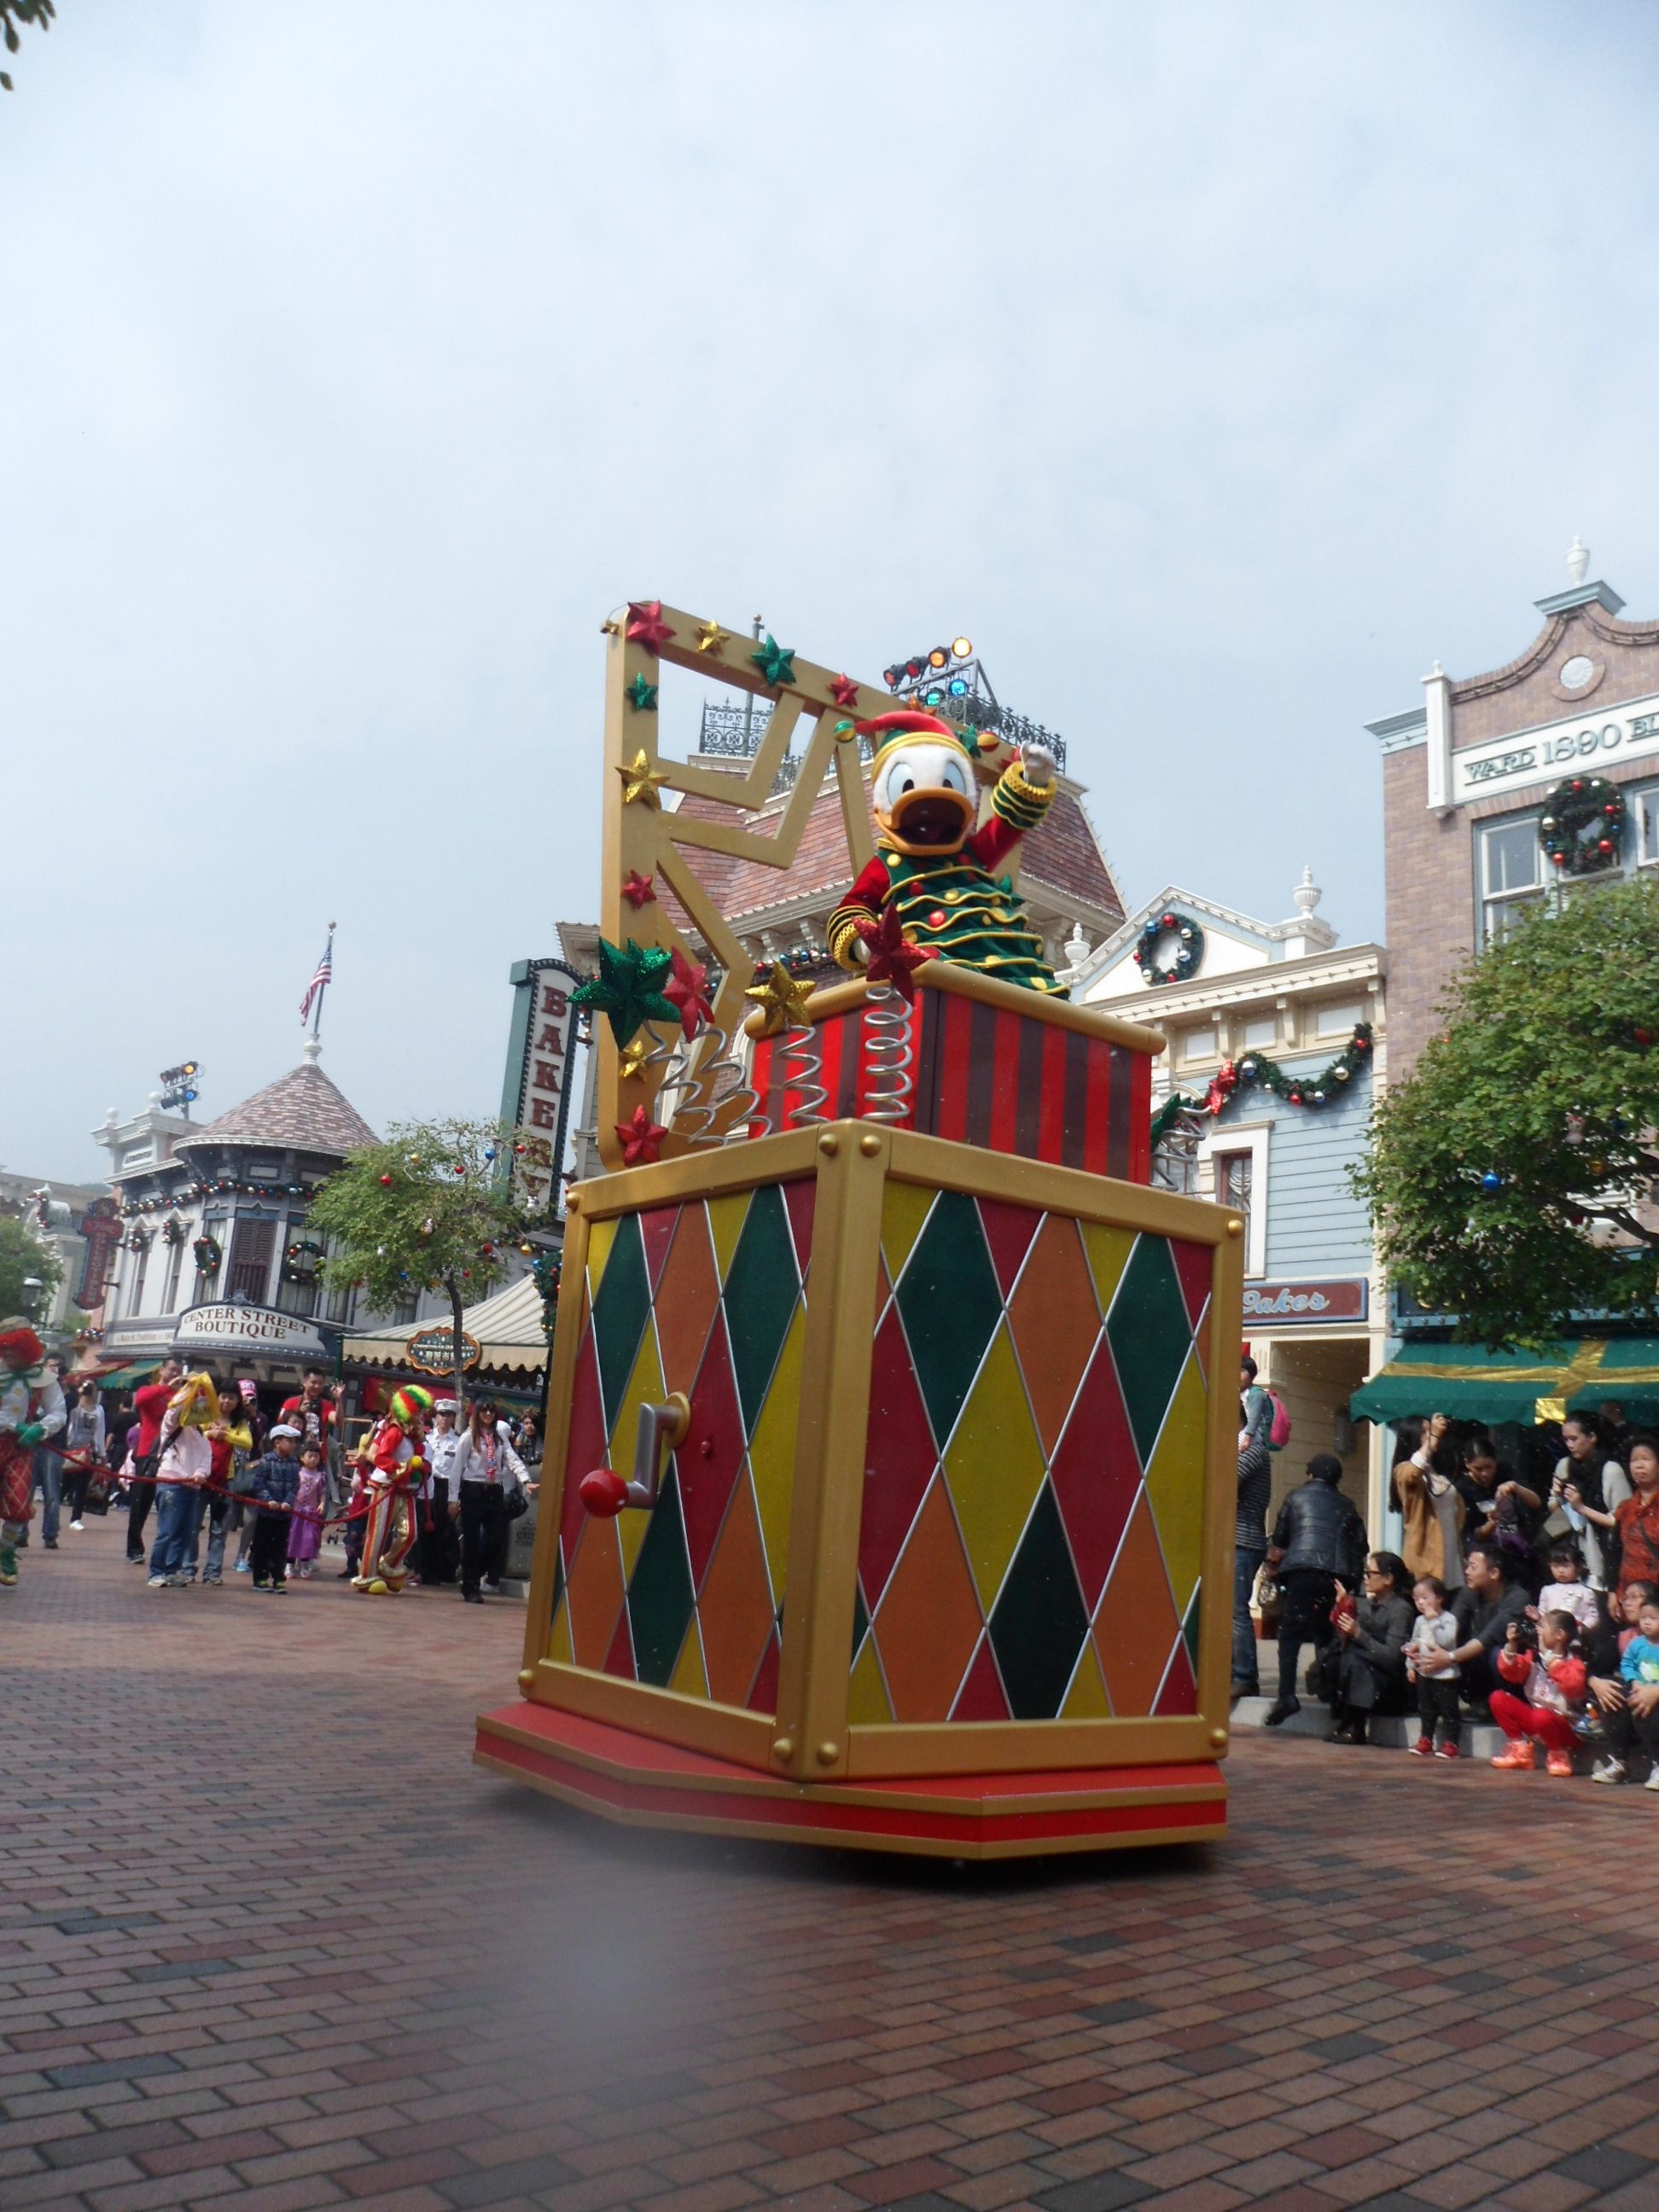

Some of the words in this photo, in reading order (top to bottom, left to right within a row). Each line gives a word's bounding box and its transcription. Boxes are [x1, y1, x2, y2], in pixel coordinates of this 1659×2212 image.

[1466, 751, 1535, 779] WARD
[1542, 725, 1621, 765] 1890
[183, 1308, 236, 1324] CENTER
[241, 1309, 311, 1334] STREET
[195, 1321, 287, 1340] BOUTIQUE
